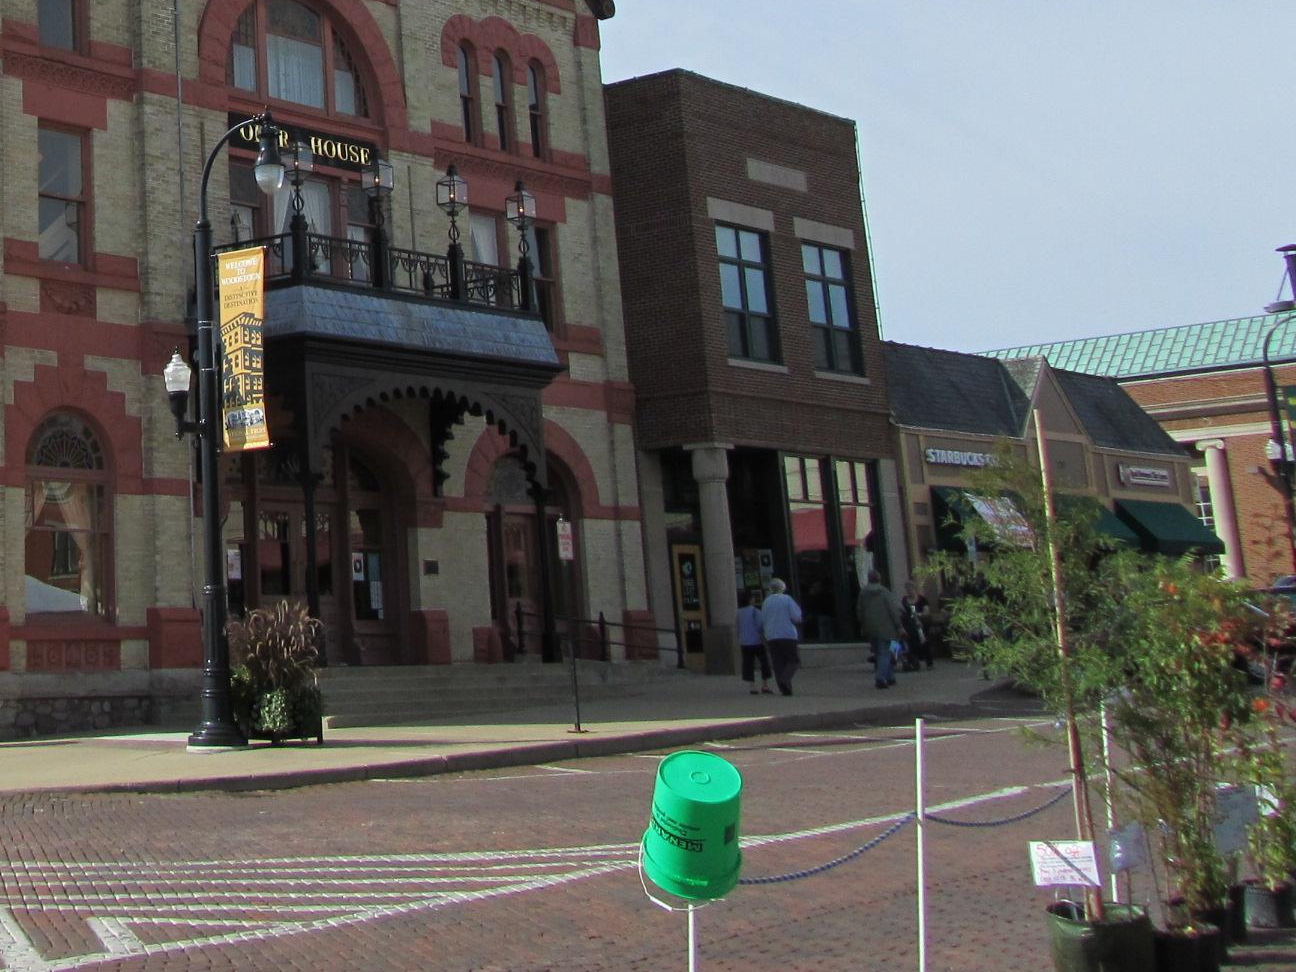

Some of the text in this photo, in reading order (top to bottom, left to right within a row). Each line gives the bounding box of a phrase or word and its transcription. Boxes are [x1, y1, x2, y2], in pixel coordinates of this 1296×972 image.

[240, 124, 371, 166] OPR HOUSE
[926, 448, 985, 467] STARBUCKS
